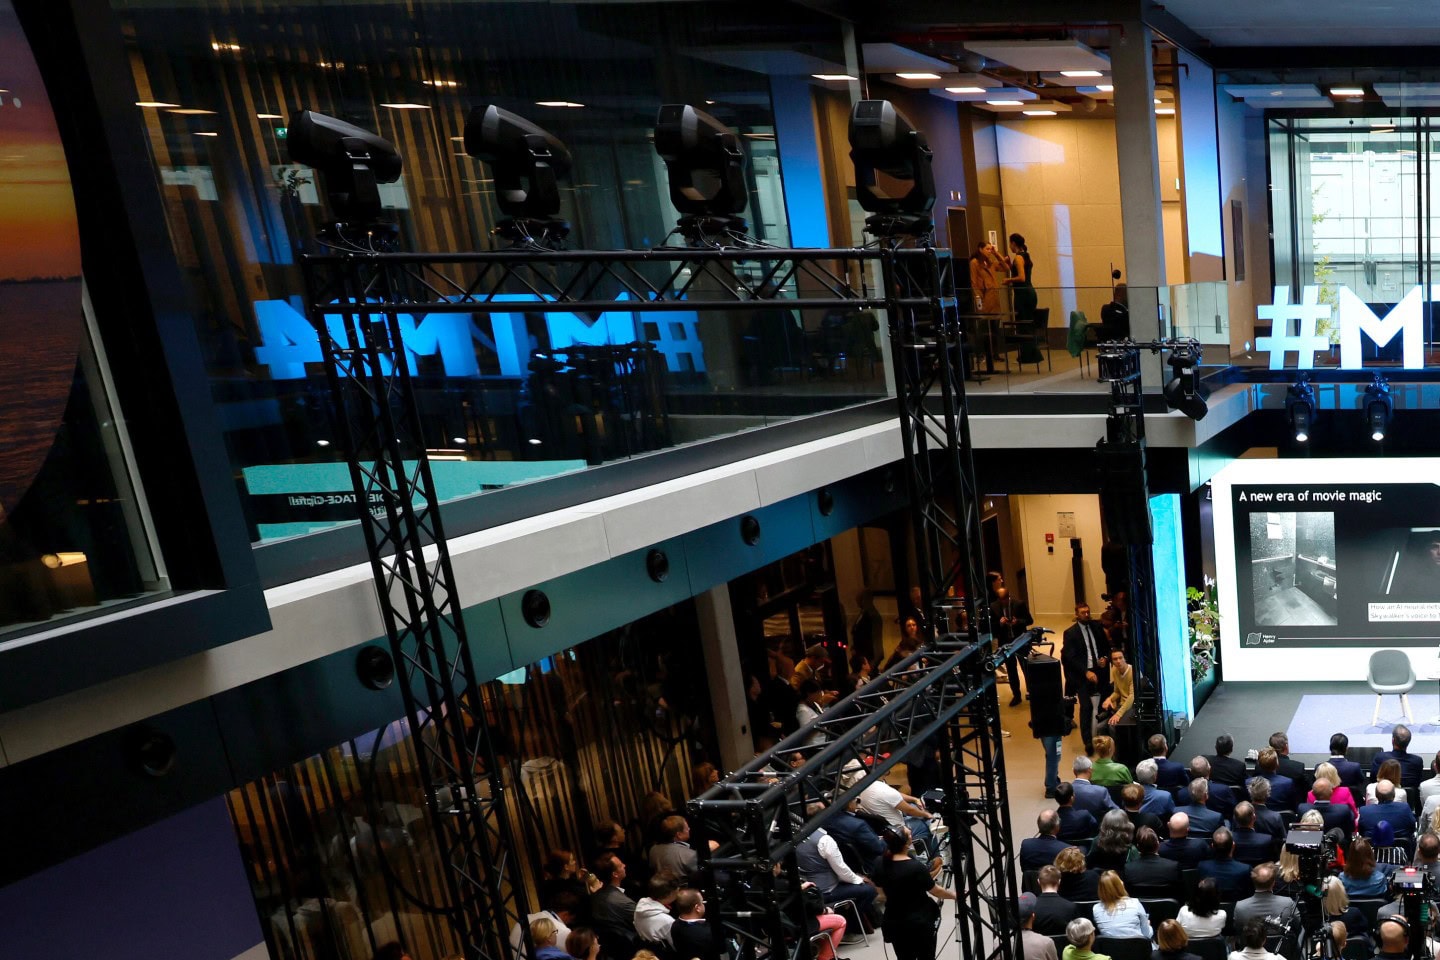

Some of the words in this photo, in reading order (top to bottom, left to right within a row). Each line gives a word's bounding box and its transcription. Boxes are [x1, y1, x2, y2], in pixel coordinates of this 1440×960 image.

[1239, 491, 1247, 501] A
[1250, 493, 1274, 501] new
[1276, 493, 1295, 501] era
[1298, 490, 1310, 501] of
[1313, 490, 1346, 501] movie
[1349, 490, 1382, 504] magic
